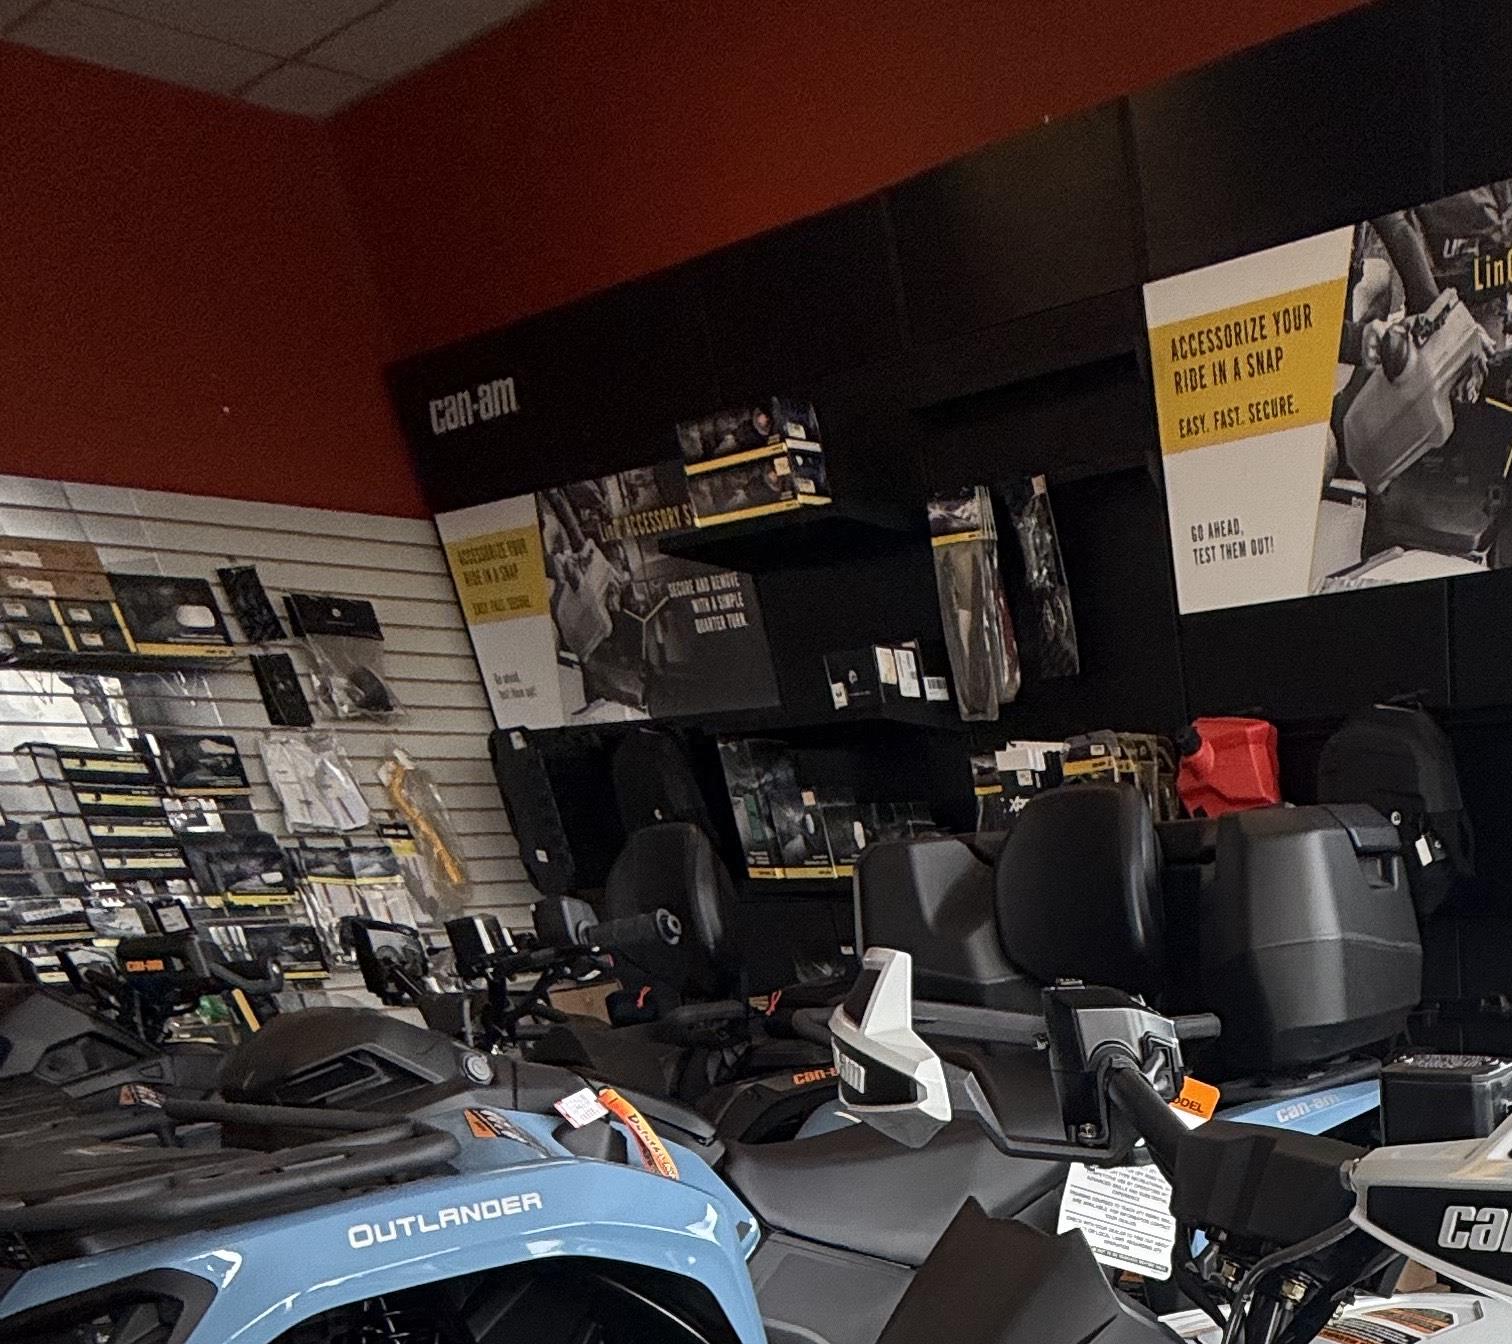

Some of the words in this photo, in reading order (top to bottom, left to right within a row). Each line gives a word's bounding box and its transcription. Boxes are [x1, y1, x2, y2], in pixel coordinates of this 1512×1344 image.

[1171, 314, 1267, 362] ACCESSORIZE
[1272, 304, 1312, 337] YOUR
[1174, 364, 1207, 395] RIDE
[1212, 360, 1227, 386] IN
[1233, 357, 1241, 381] A
[1247, 346, 1283, 378] SNAP
[429, 377, 517, 436] can-am
[1179, 414, 1209, 438] EASY.
[1214, 406, 1244, 430] FAST.
[1248, 395, 1299, 424] SECURE.
[1191, 524, 1204, 542] GO
[1208, 518, 1244, 539] AHEAD,
[1193, 545, 1217, 566] TEST
[1220, 540, 1247, 561] THEM
[1250, 535, 1274, 557] OUT!
[1276, 1093, 1341, 1123] can-am
[348, 1192, 543, 1249] OUTLANDER
